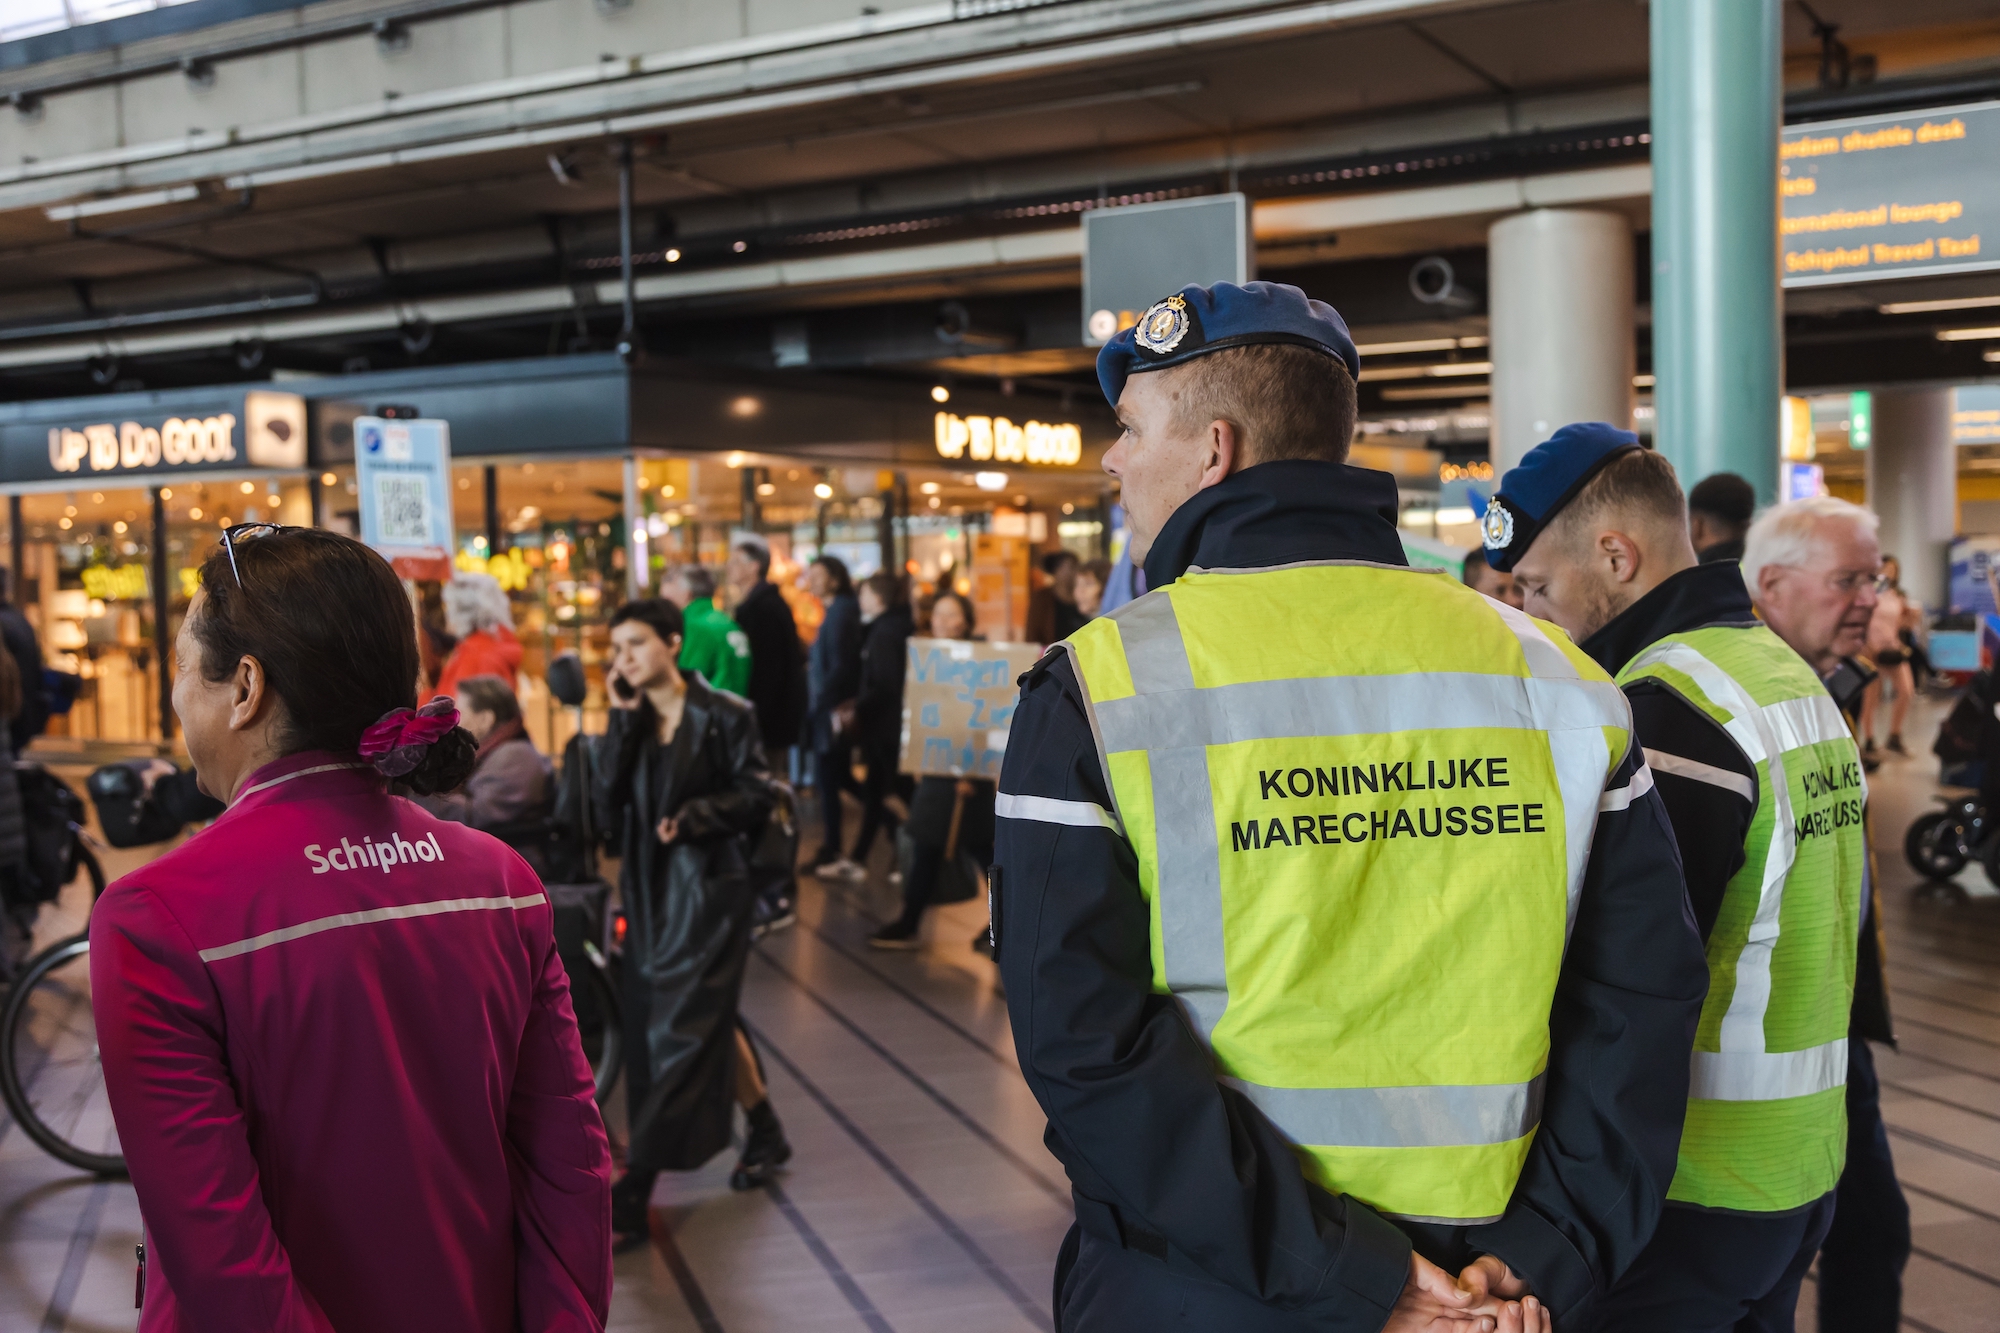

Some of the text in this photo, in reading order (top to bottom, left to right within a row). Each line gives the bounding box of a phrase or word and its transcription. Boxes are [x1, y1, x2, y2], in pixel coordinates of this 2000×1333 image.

[1842, 125, 1913, 152] shuttle
[1916, 118, 1966, 143] desk
[1890, 201, 1963, 224] lounge
[1785, 234, 1980, 272] Schiphol Travel Taxi
[1259, 757, 1510, 800] KONINKLIJKE
[1231, 803, 1546, 852] MARECHAUSSEE
[303, 831, 445, 874] Schiphol
